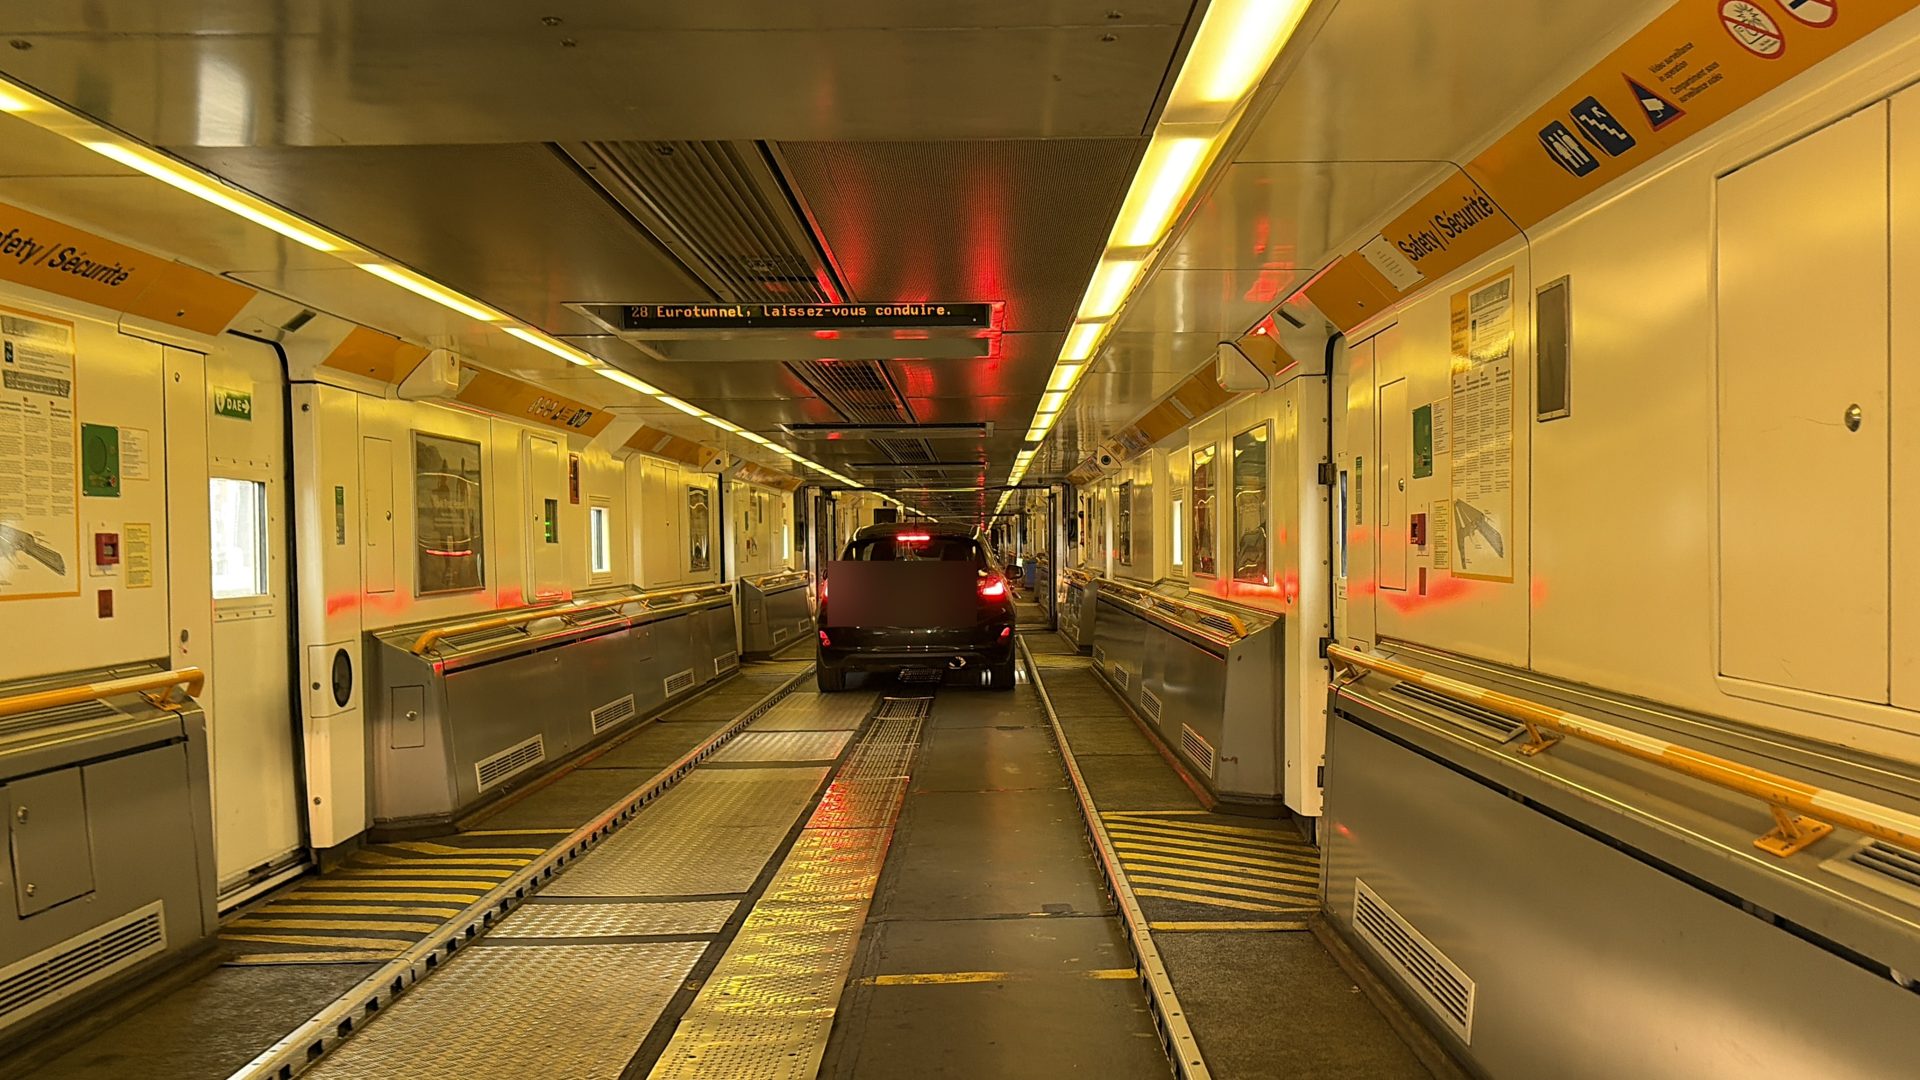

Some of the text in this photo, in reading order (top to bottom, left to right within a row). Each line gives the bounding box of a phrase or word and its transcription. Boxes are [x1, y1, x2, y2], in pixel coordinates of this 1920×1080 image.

[631, 304, 951, 318] 28 Eurotunnel, laissez-vous conduire.
[226, 398, 242, 412] DAE
